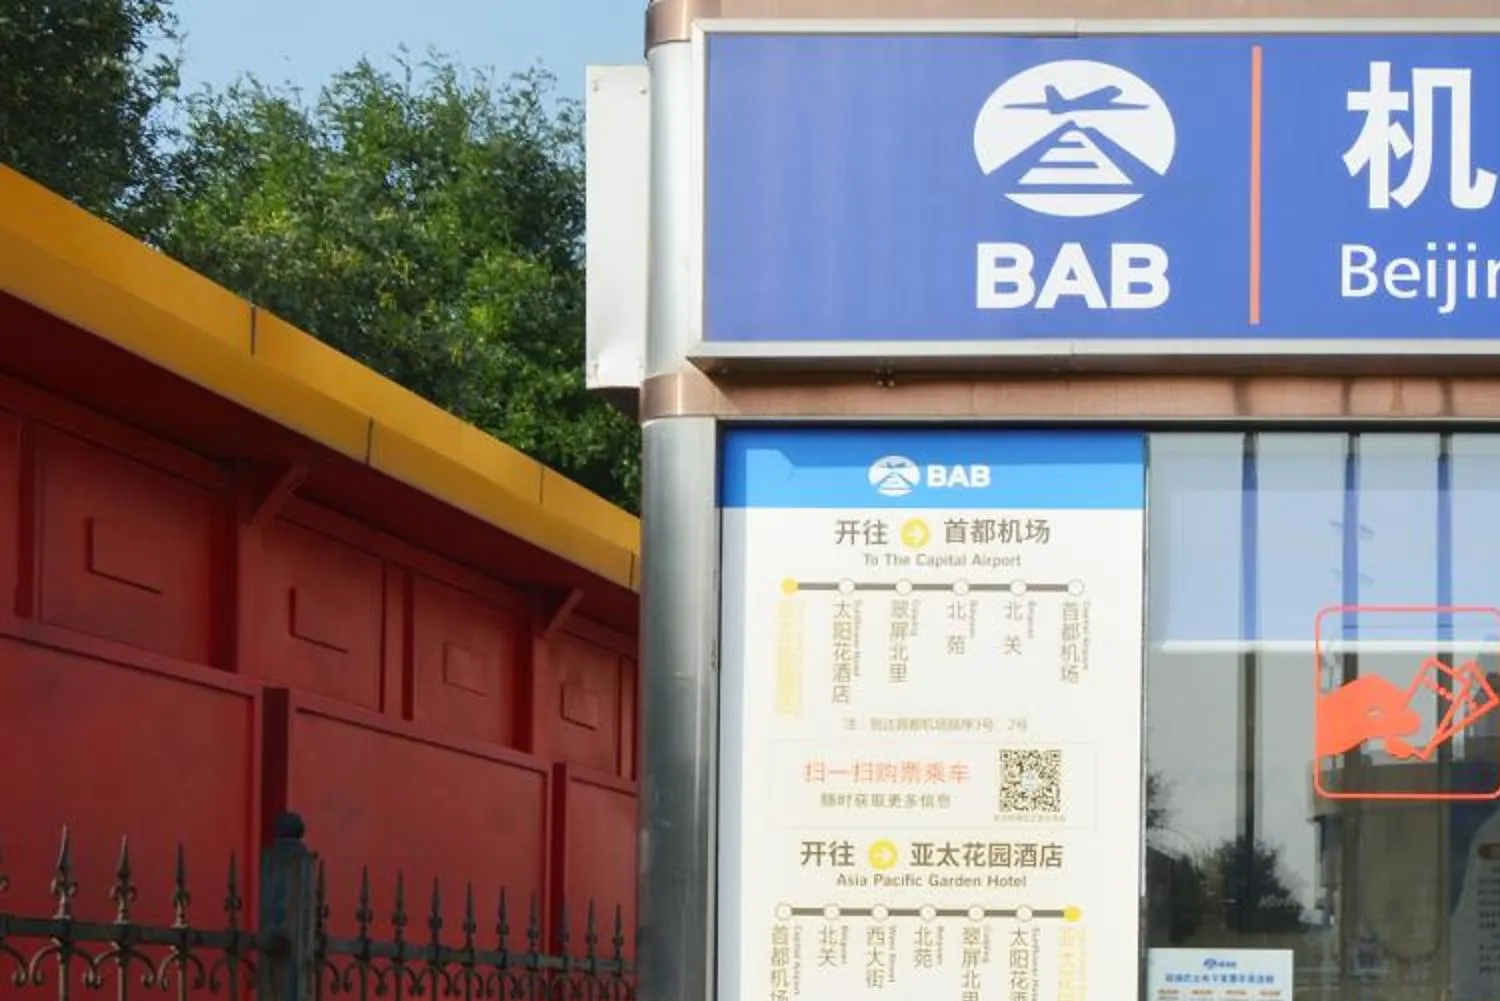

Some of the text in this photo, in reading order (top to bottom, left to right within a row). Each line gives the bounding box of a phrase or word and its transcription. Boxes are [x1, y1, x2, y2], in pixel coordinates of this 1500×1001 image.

[976, 242, 1170, 308] BAB
[928, 465, 990, 487] BAB
[835, 518, 1050, 546] 开往 首都机场
[885, 553, 910, 567] The
[914, 553, 967, 569] Capital
[972, 554, 1021, 569] Airport
[833, 602, 853, 704] 太阳花酒店
[803, 760, 972, 786] 扫一扫购票乘车
[800, 841, 1064, 868] 开往 亚太花园酒店
[836, 873, 1027, 888] Asia Pacific Garden Hotel
[818, 926, 838, 967] 北关
[866, 927, 884, 989] 西大街
[914, 926, 933, 968] 北苑
